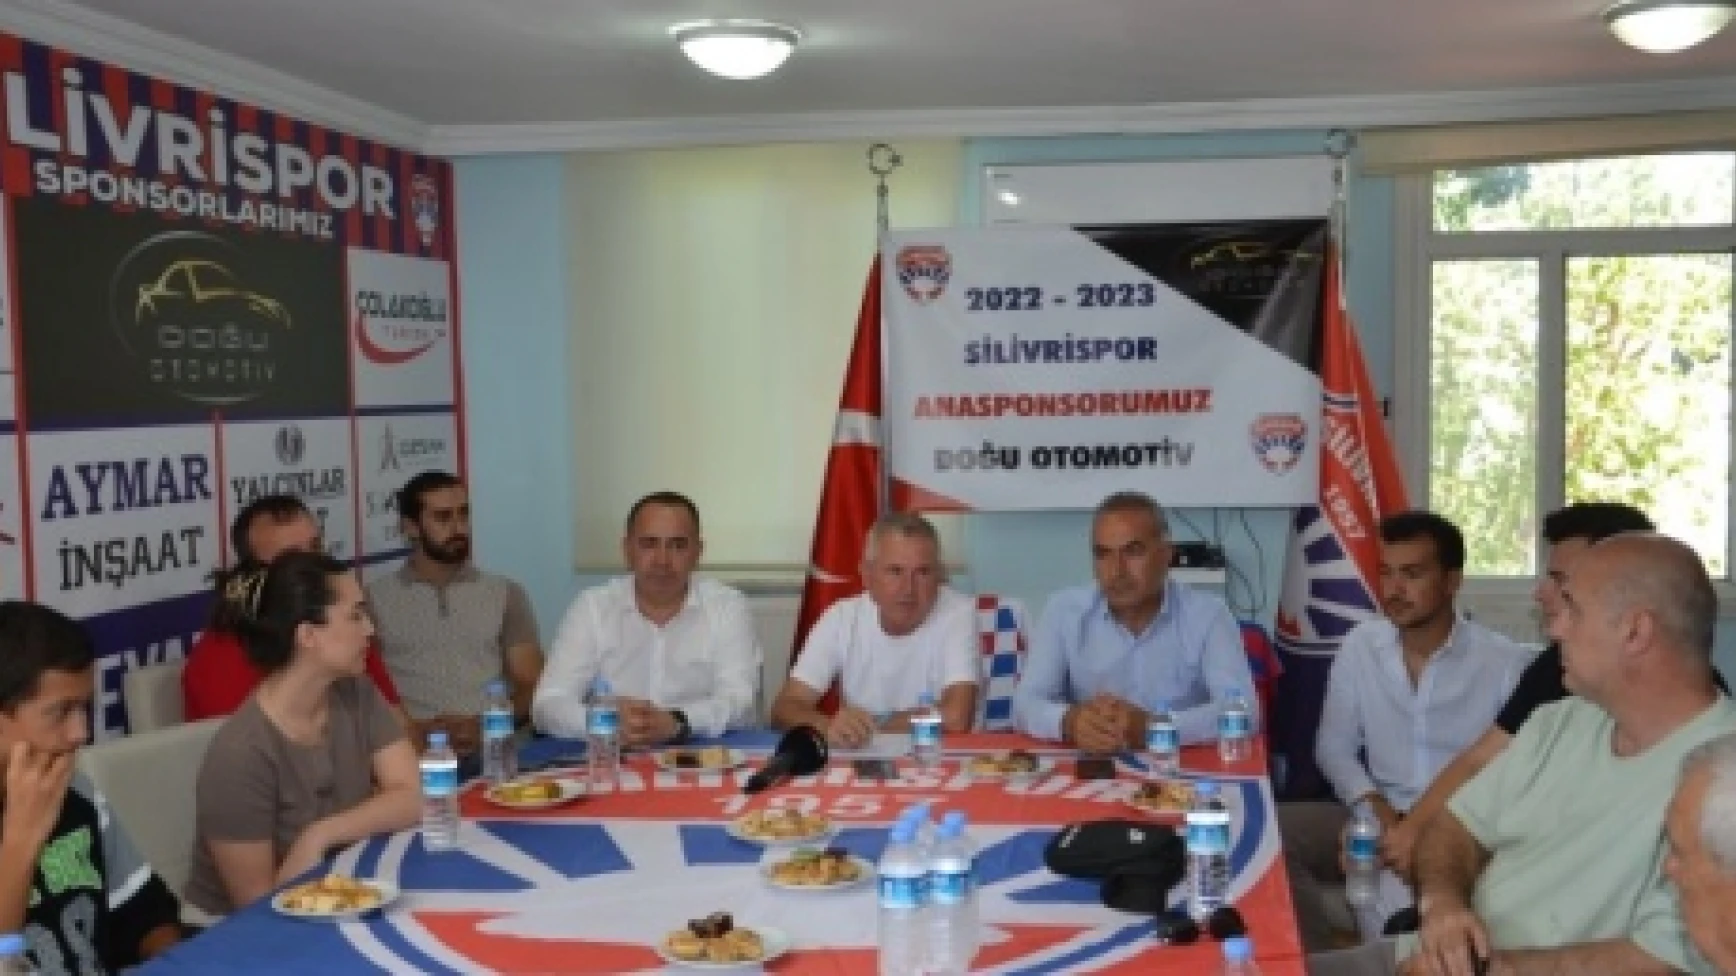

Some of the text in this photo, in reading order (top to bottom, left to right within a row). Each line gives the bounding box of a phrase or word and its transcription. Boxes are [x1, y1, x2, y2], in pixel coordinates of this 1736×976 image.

[34, 158, 333, 239] SPONSORLARIMIZ
[966, 287, 1042, 311] 2022
[1077, 283, 1158, 309] 2023
[963, 332, 1158, 365] SİLİVRİSPOR
[913, 388, 1214, 420] ANASPONSORUMUZ
[934, 435, 1196, 472] DOĞU OTOMOTİV
[40, 453, 212, 522] AYMAR
[57, 526, 205, 591] İNŞAAT
